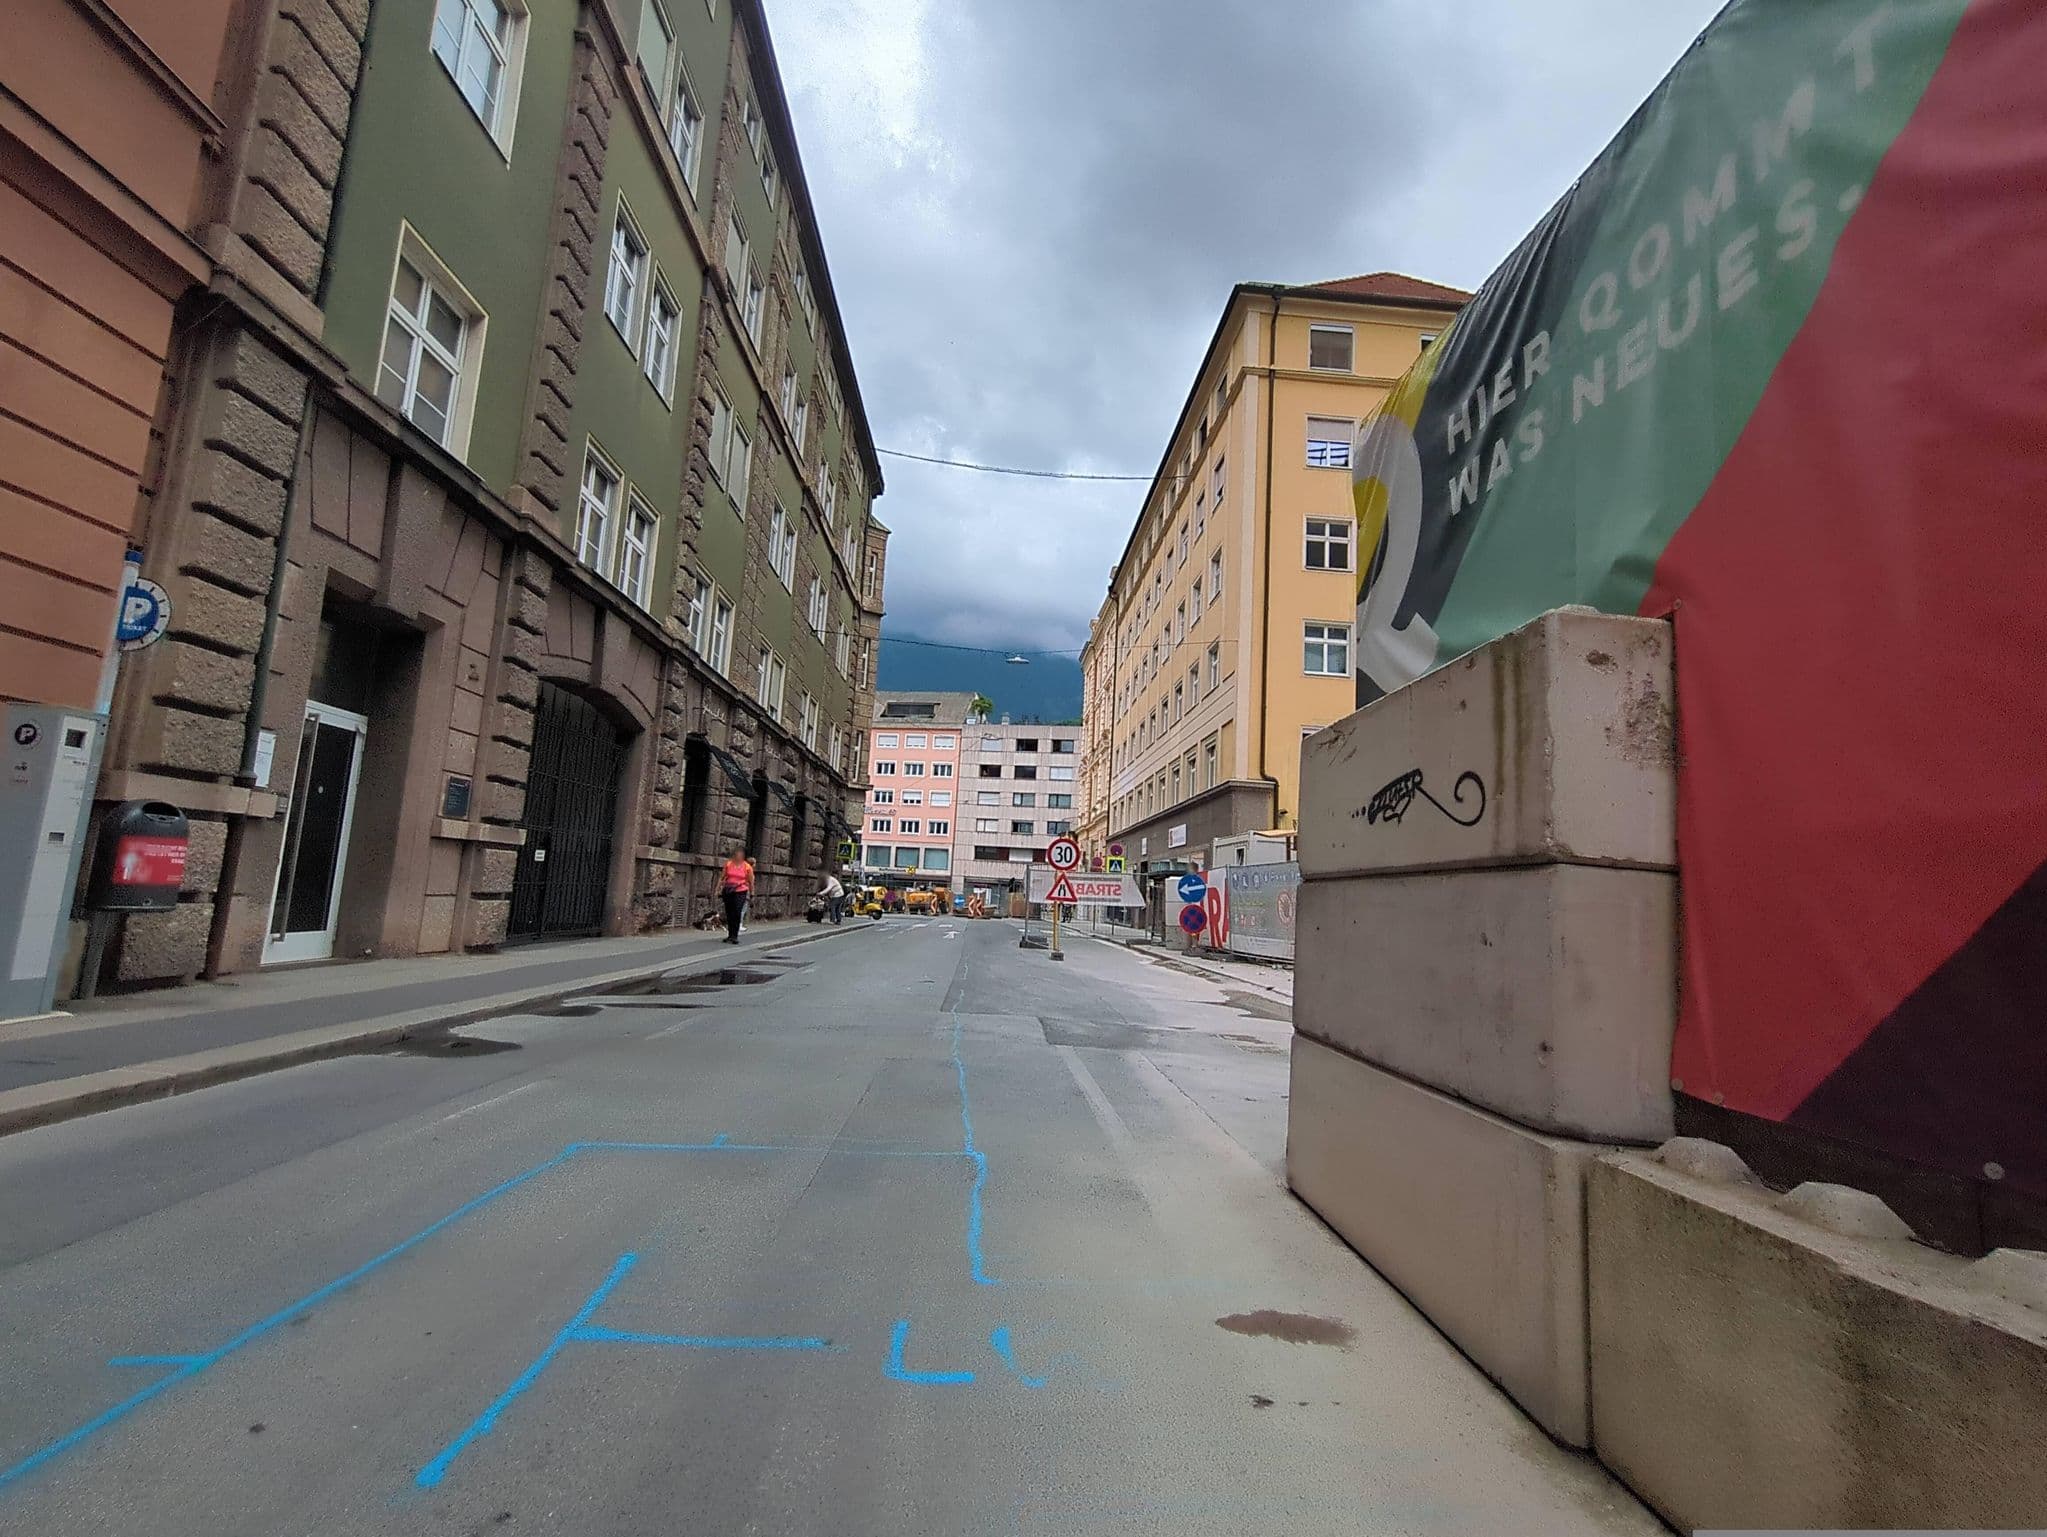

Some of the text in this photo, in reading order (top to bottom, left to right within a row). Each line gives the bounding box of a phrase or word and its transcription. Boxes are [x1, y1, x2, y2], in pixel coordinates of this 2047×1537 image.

[1448, 10, 1892, 453] HIER QOMMT
[1449, 182, 1863, 516] WAS NEUES.
[123, 597, 152, 624] P
[1055, 846, 1073, 864] 30
